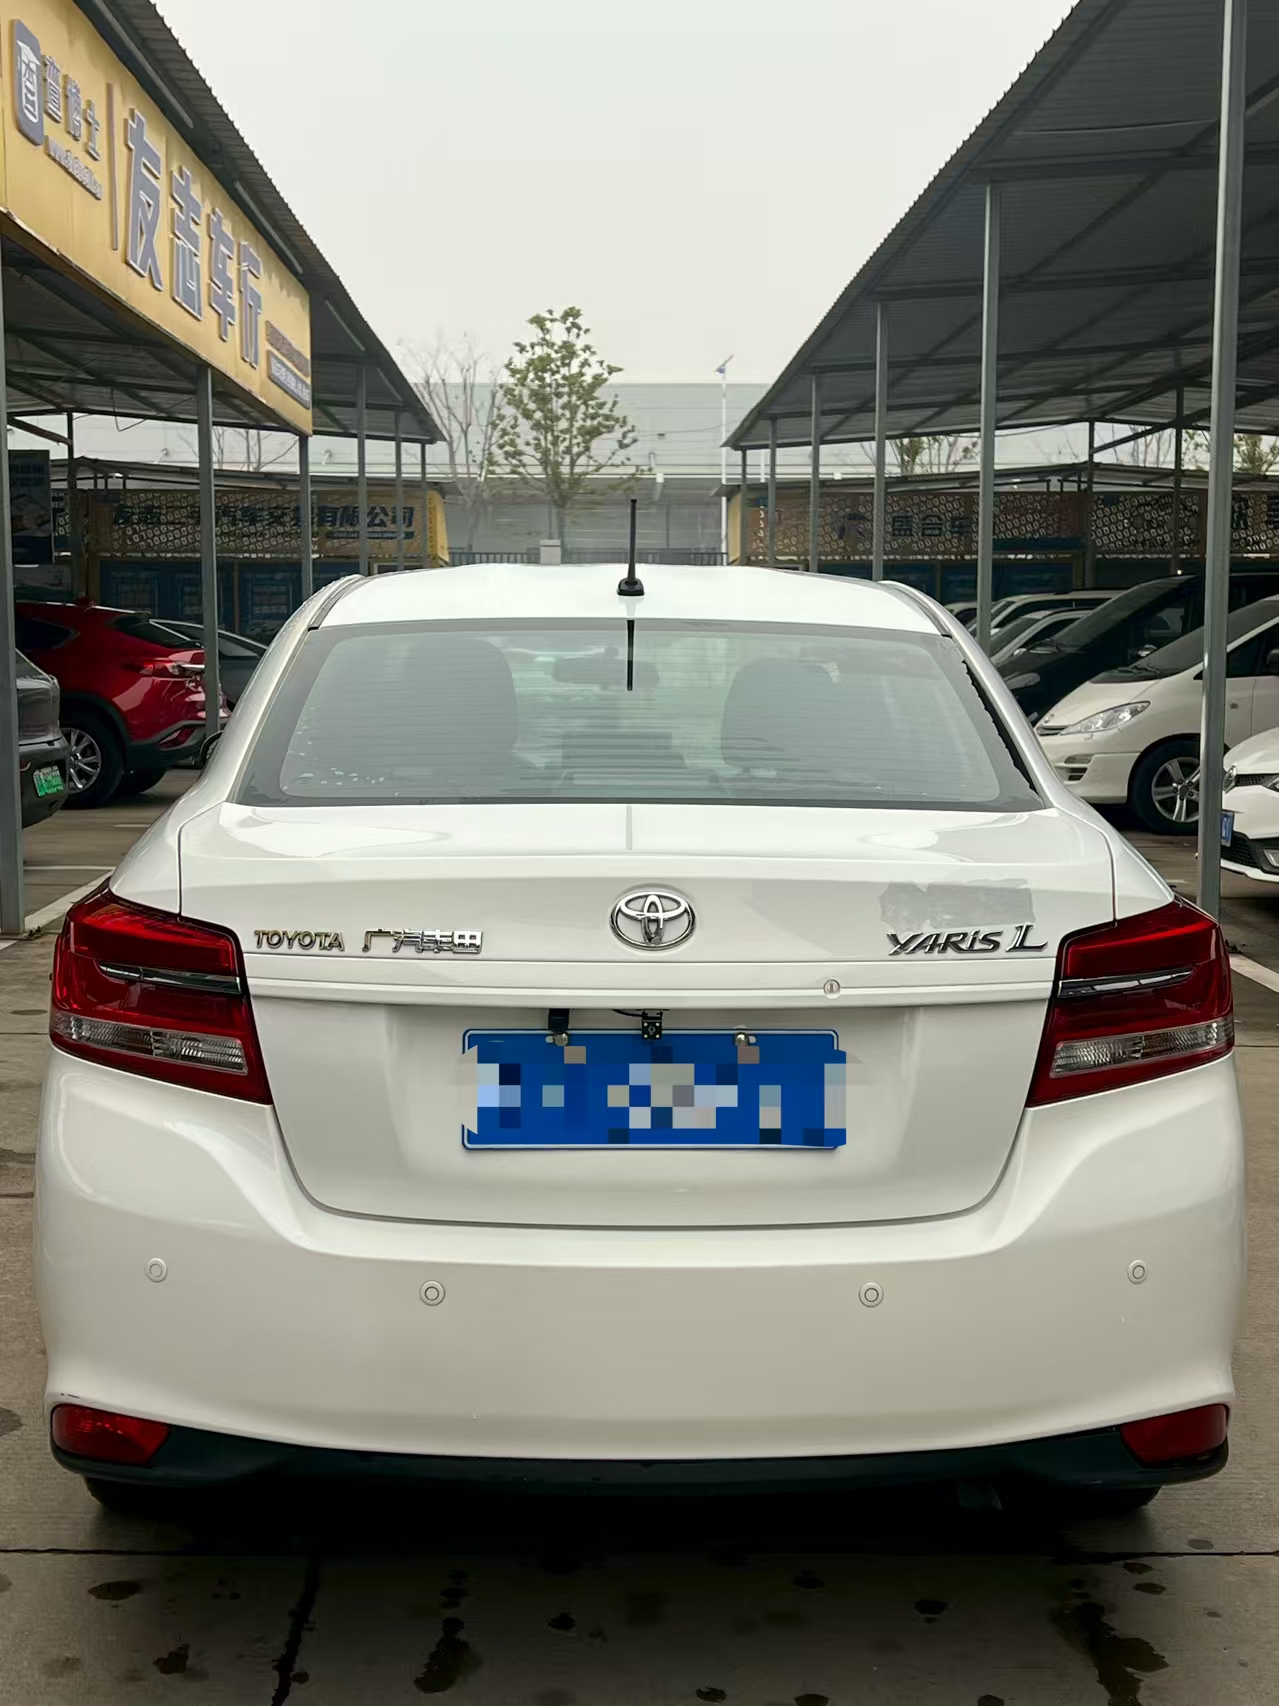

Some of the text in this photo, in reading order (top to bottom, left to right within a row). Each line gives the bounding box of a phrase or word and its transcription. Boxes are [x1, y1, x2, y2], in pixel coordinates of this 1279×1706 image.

[124, 108, 262, 370] 友志车行
[254, 930, 345, 952] TOYOTA
[1005, 924, 1048, 953] L
